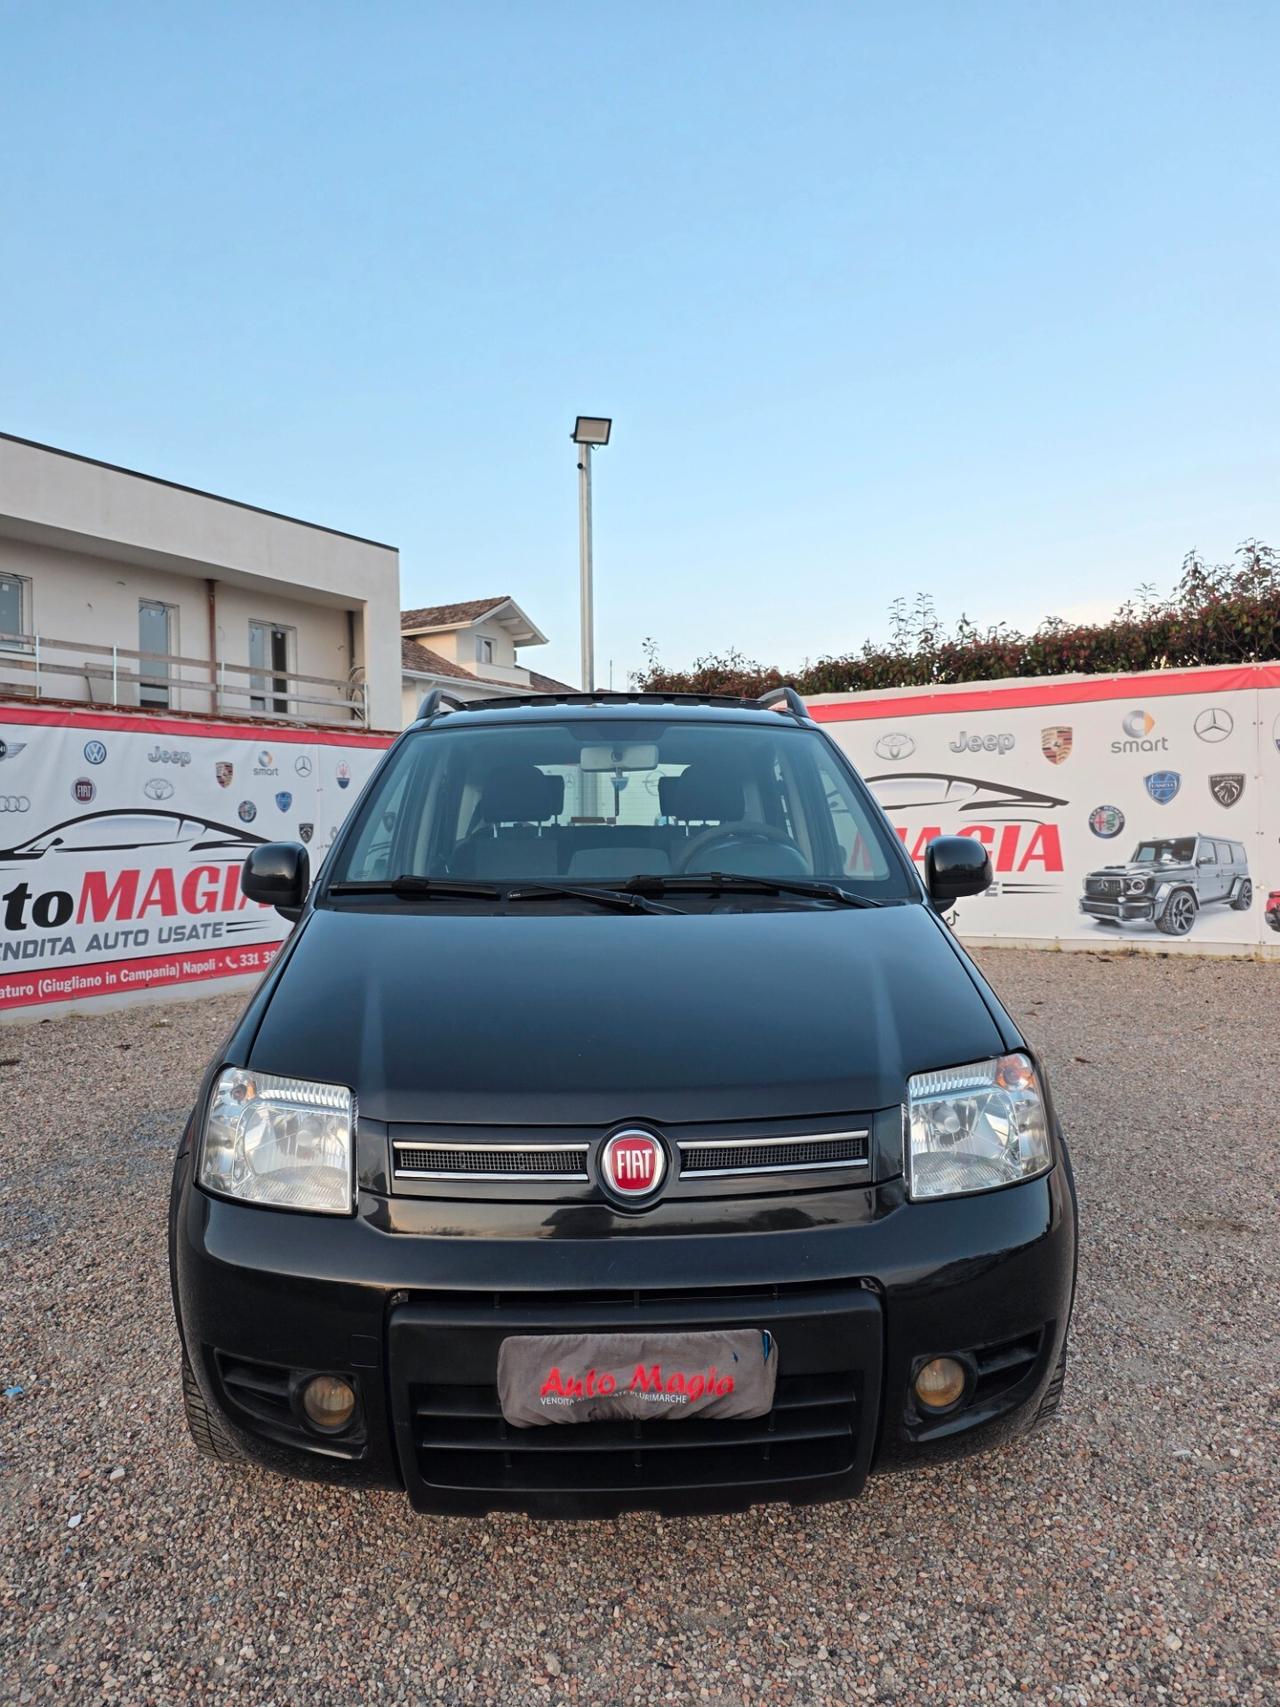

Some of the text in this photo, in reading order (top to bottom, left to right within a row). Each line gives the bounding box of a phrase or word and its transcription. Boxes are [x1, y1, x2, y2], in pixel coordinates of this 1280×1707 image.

[949, 731, 1016, 755] Jeep
[1111, 737, 1168, 754] smart
[148, 746, 192, 768] Jeep
[253, 767, 279, 777] smart
[77, 785, 92, 798] FIAT
[0, 922, 224, 961] NDITA AUTO USATE
[38, 975, 102, 997] (Giugliano
[105, 971, 117, 985] in
[120, 963, 180, 982] Campania)
[183, 958, 216, 974] Napoli
[239, 952, 259, 966] 331
[616, 1148, 653, 1180] FIAT
[540, 1363, 735, 1403] Auto Magia
[540, 1397, 575, 1406] VENDITA
